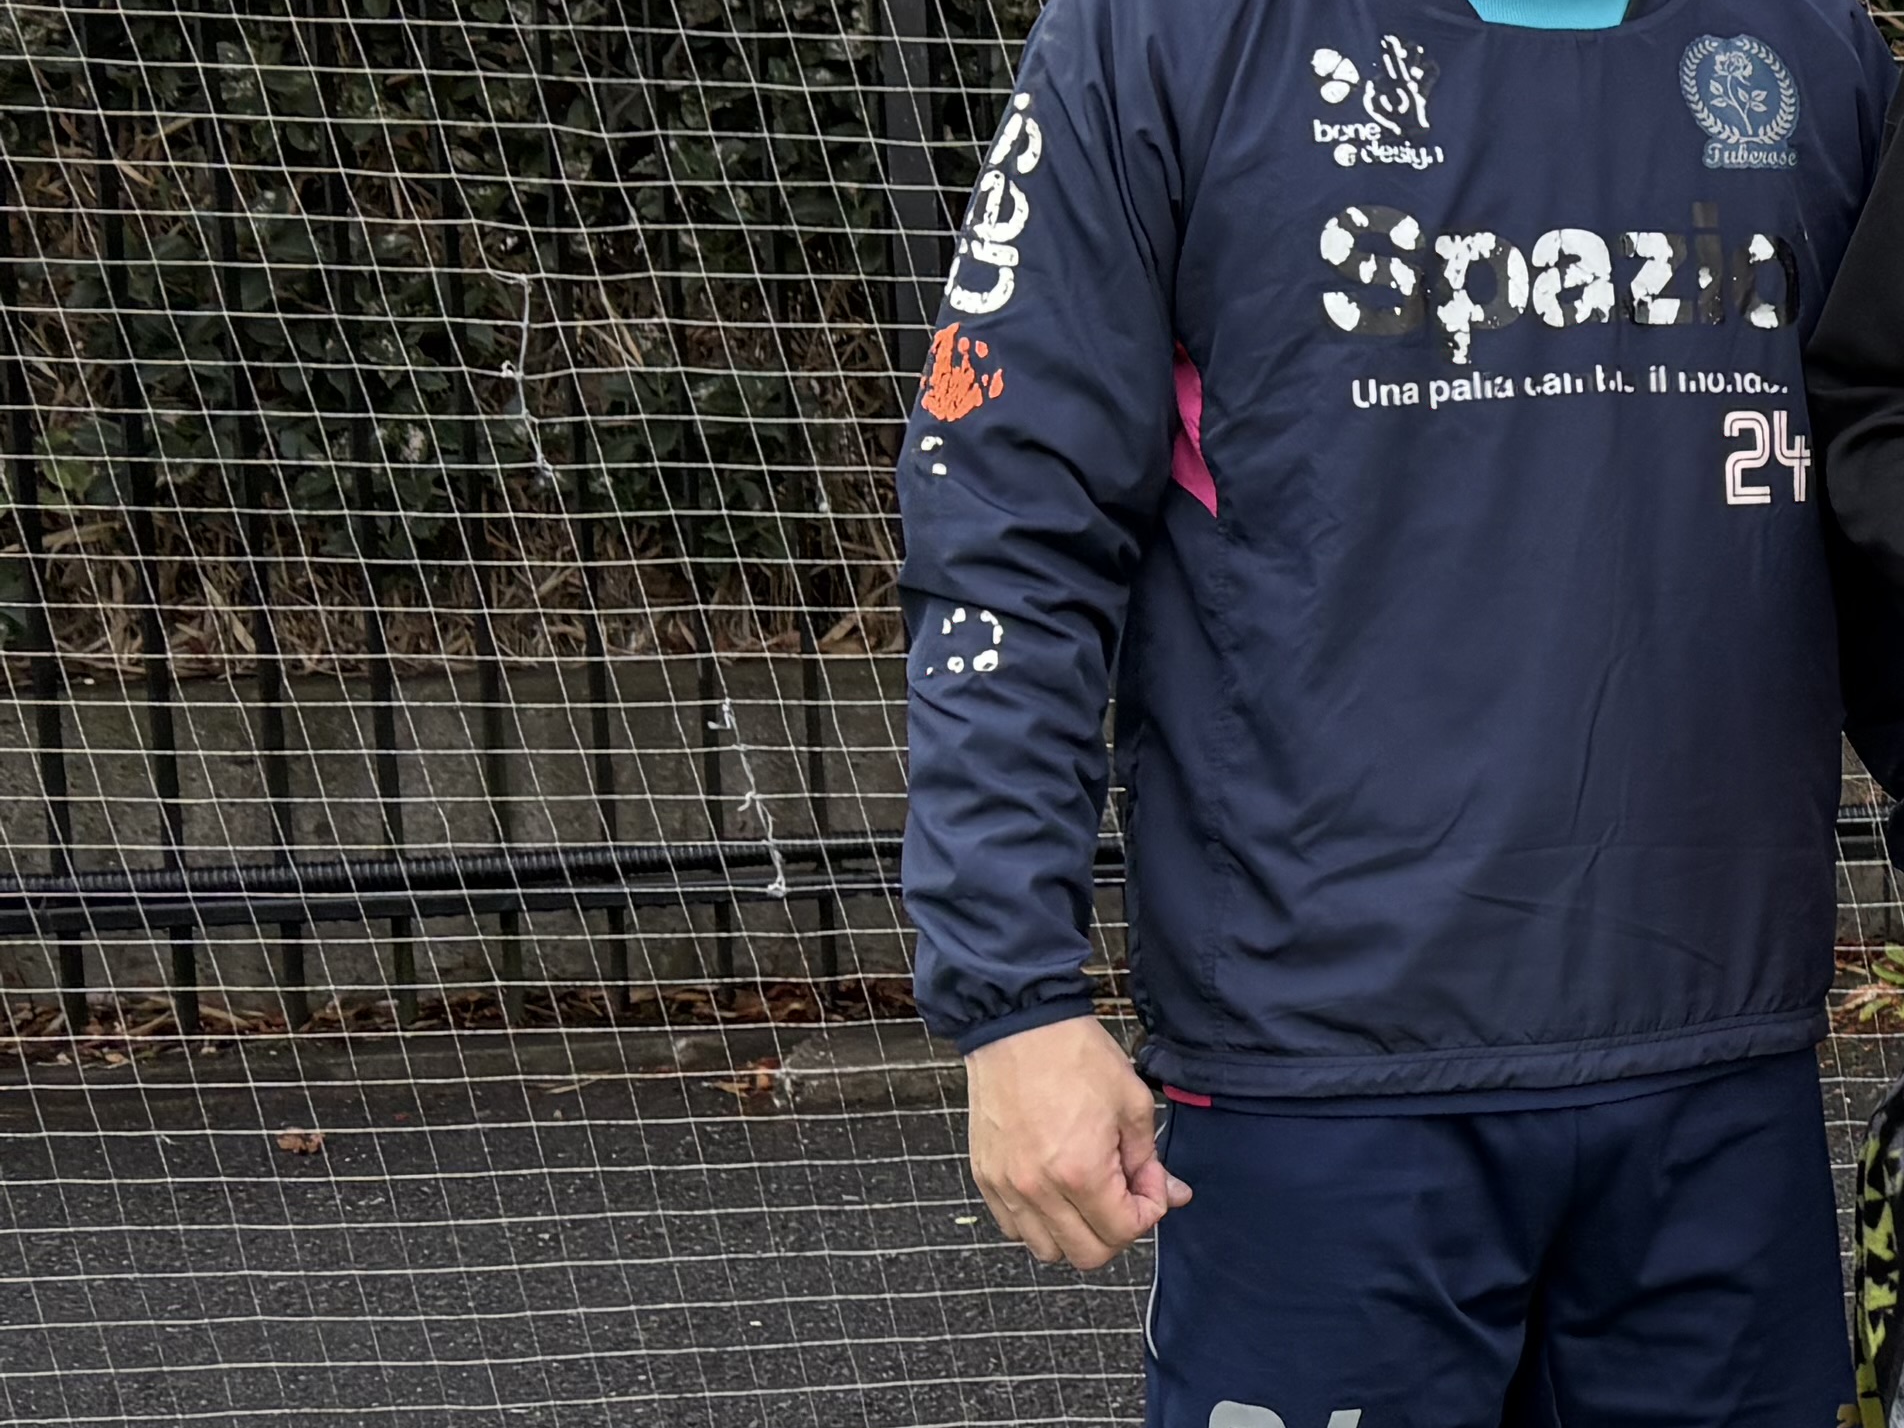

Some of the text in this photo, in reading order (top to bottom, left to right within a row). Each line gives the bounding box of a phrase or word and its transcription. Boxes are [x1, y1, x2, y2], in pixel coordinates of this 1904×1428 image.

[1705, 142, 1798, 167] Tuberose
[1351, 377, 1420, 409] Una
[1649, 364, 1667, 393] il
[1723, 409, 1811, 505] 24
